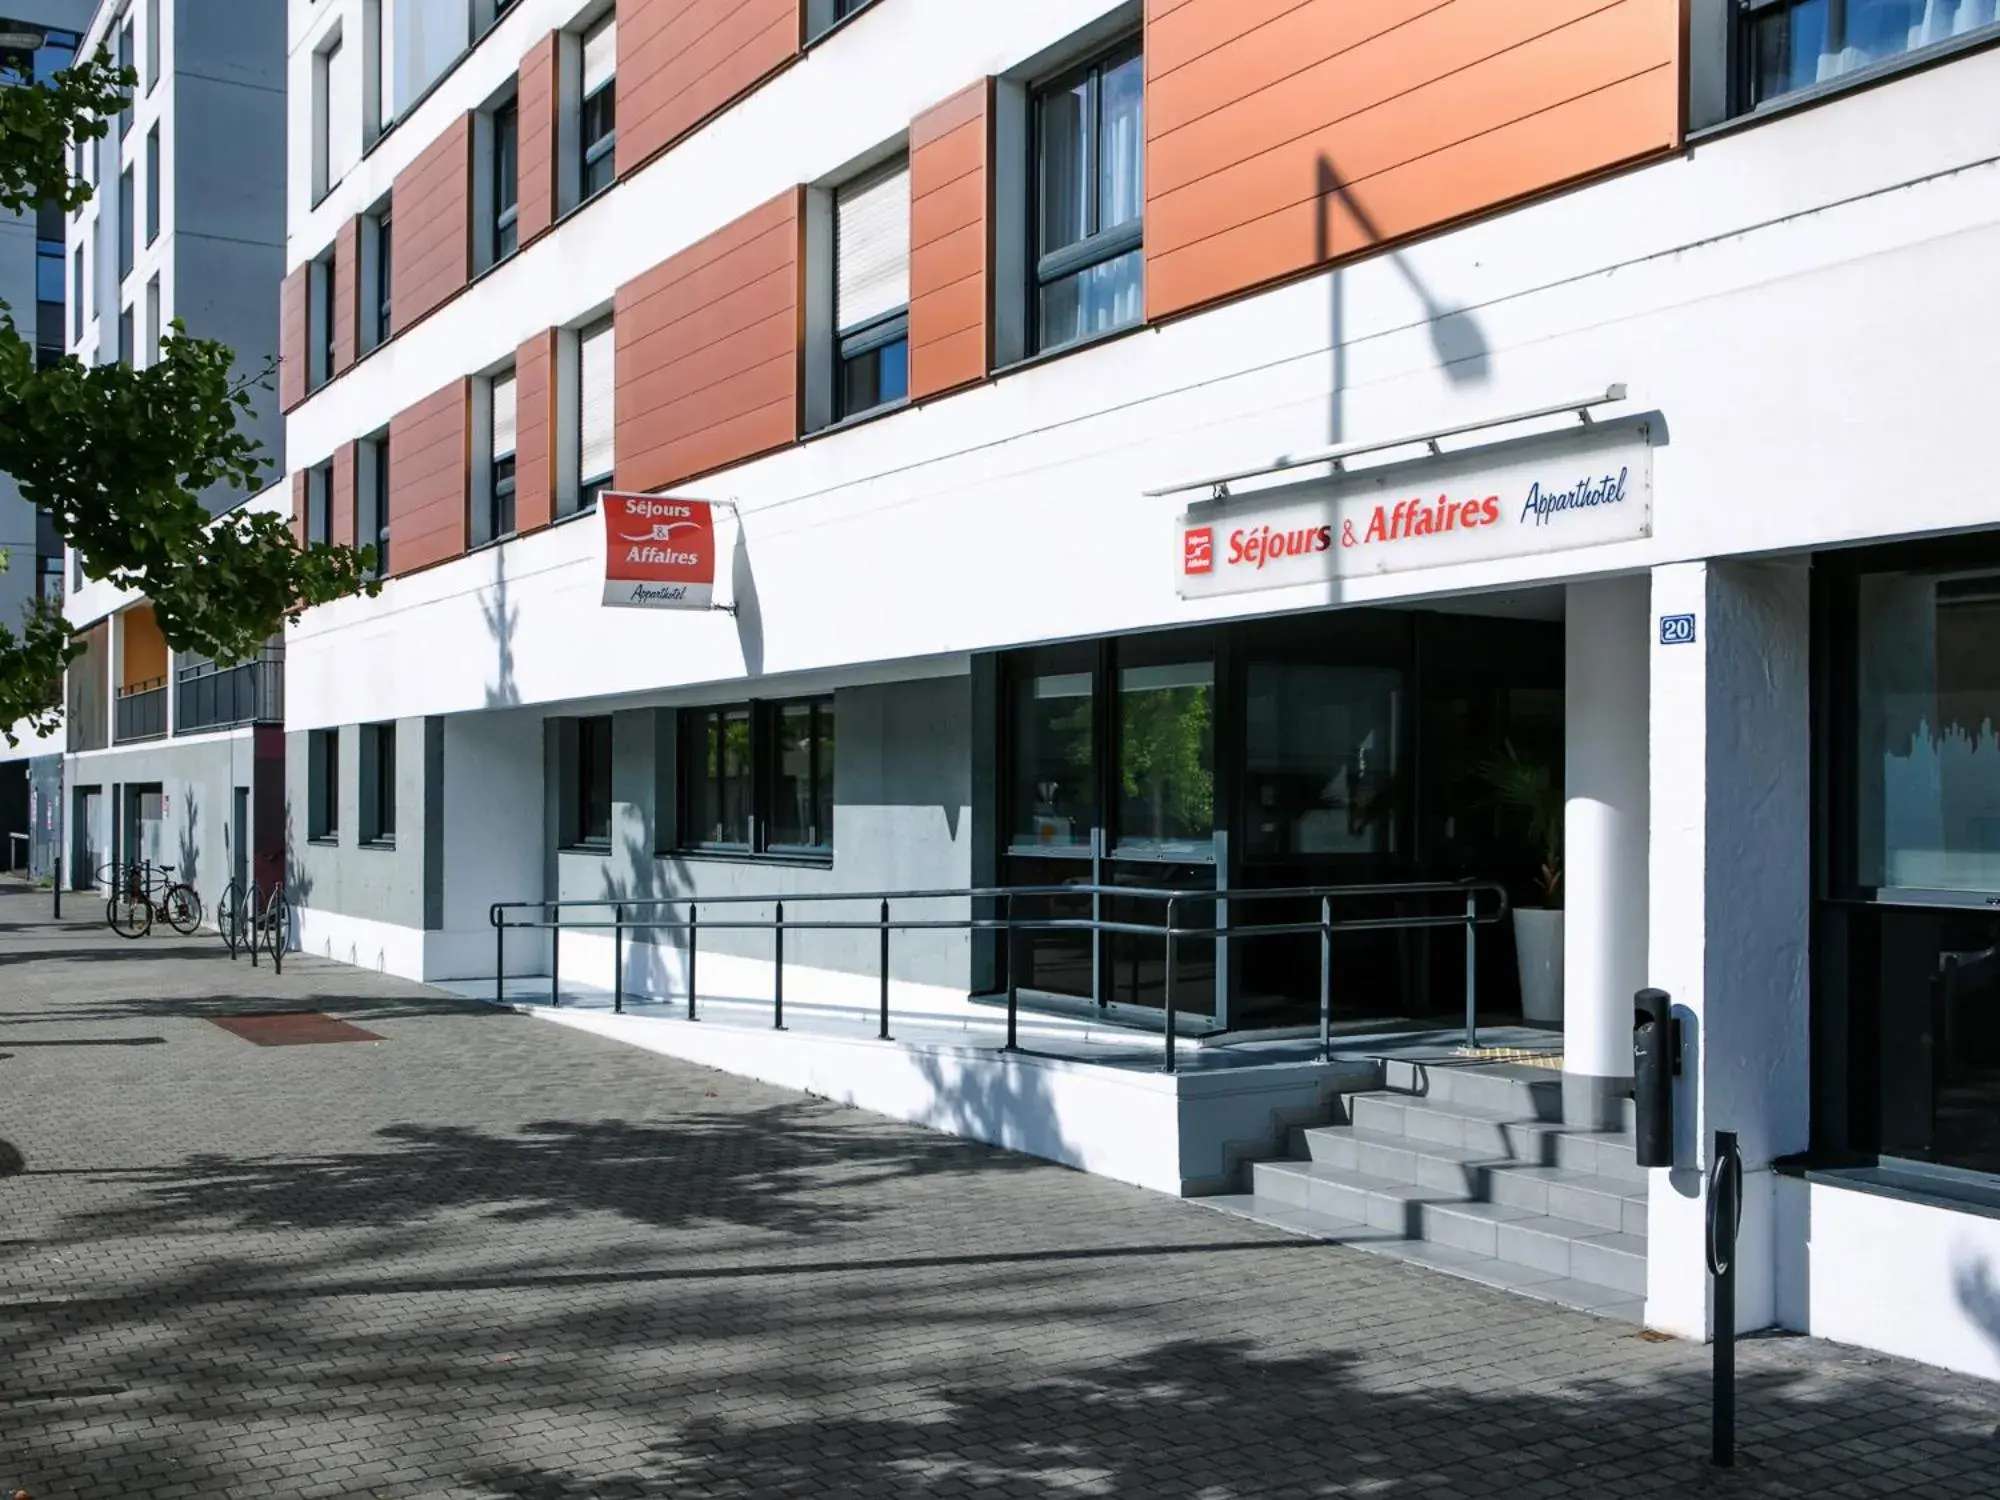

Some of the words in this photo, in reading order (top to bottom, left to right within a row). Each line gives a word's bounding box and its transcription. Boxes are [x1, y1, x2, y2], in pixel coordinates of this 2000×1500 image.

[626, 500, 691, 518] Séjours
[1228, 525, 1331, 569] Séjours
[1342, 519, 1357, 547] &
[1364, 494, 1498, 544] Affaires
[1521, 466, 1627, 525] Apparthotel
[627, 546, 698, 565] Affaires
[631, 583, 687, 602] Apparthotel
[1664, 620, 1689, 638] 20
